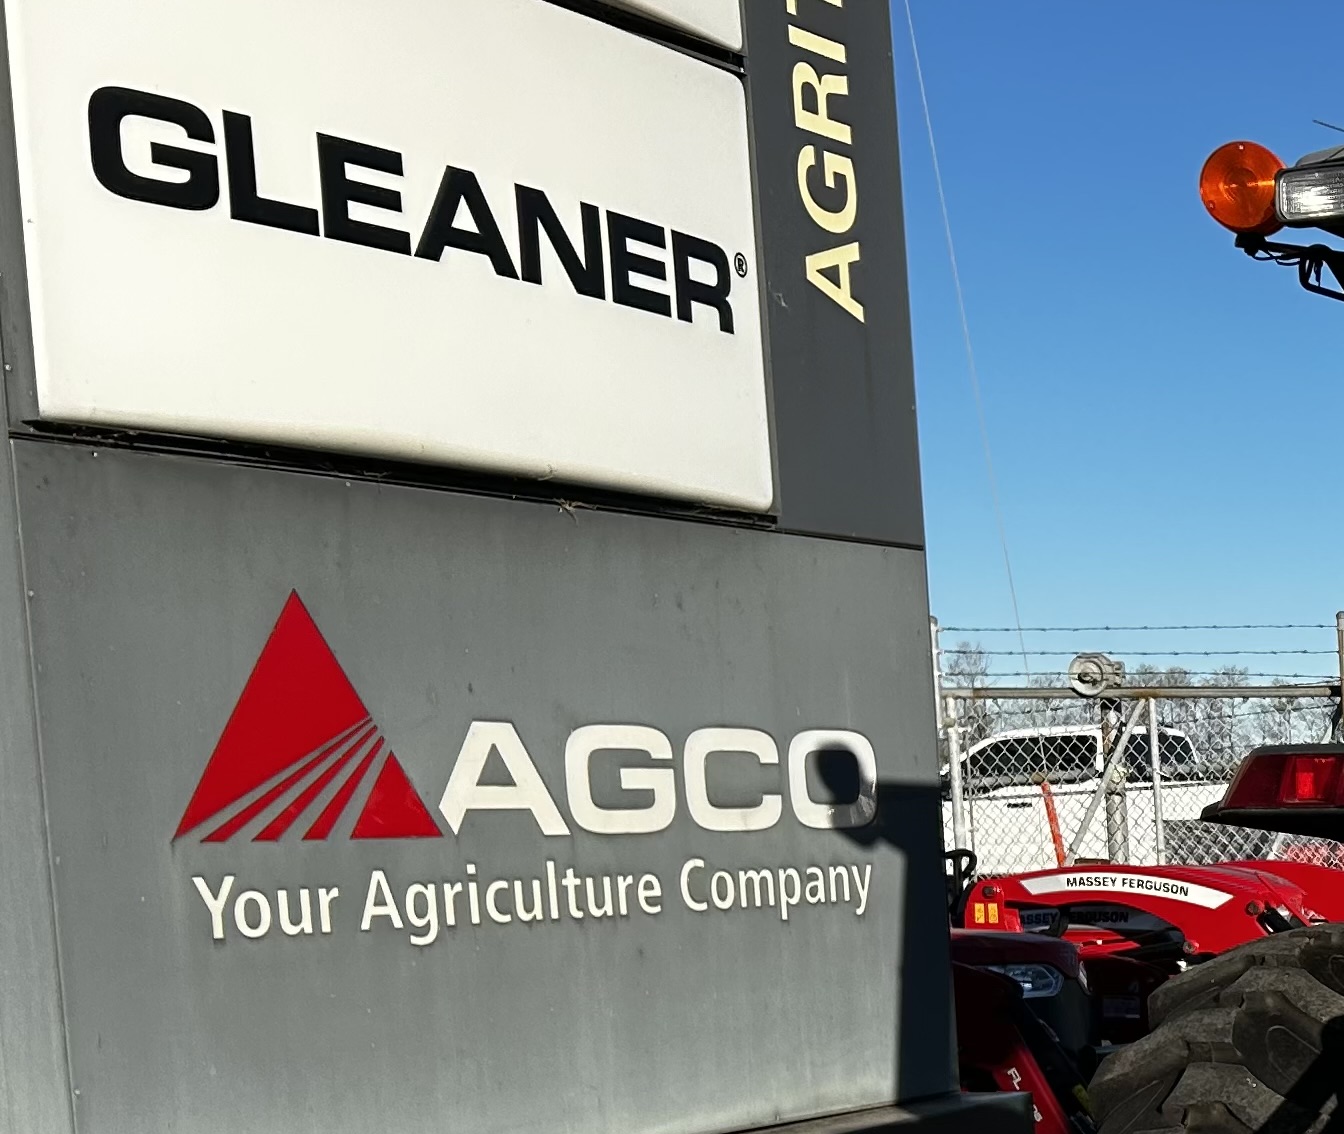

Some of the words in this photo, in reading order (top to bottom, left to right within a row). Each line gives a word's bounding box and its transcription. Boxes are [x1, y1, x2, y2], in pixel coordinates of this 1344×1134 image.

[786, 0, 865, 324] AGRI
[438, 720, 877, 836] AGCO
[191, 875, 339, 939] Your
[360, 860, 662, 946] Agriculture
[680, 858, 872, 921] Company
[1021, 911, 1058, 925] SSEY
[1069, 910, 1129, 923] ERGUSON
[1066, 876, 1117, 888] MASSEY
[1121, 877, 1189, 897] FERGUSON
